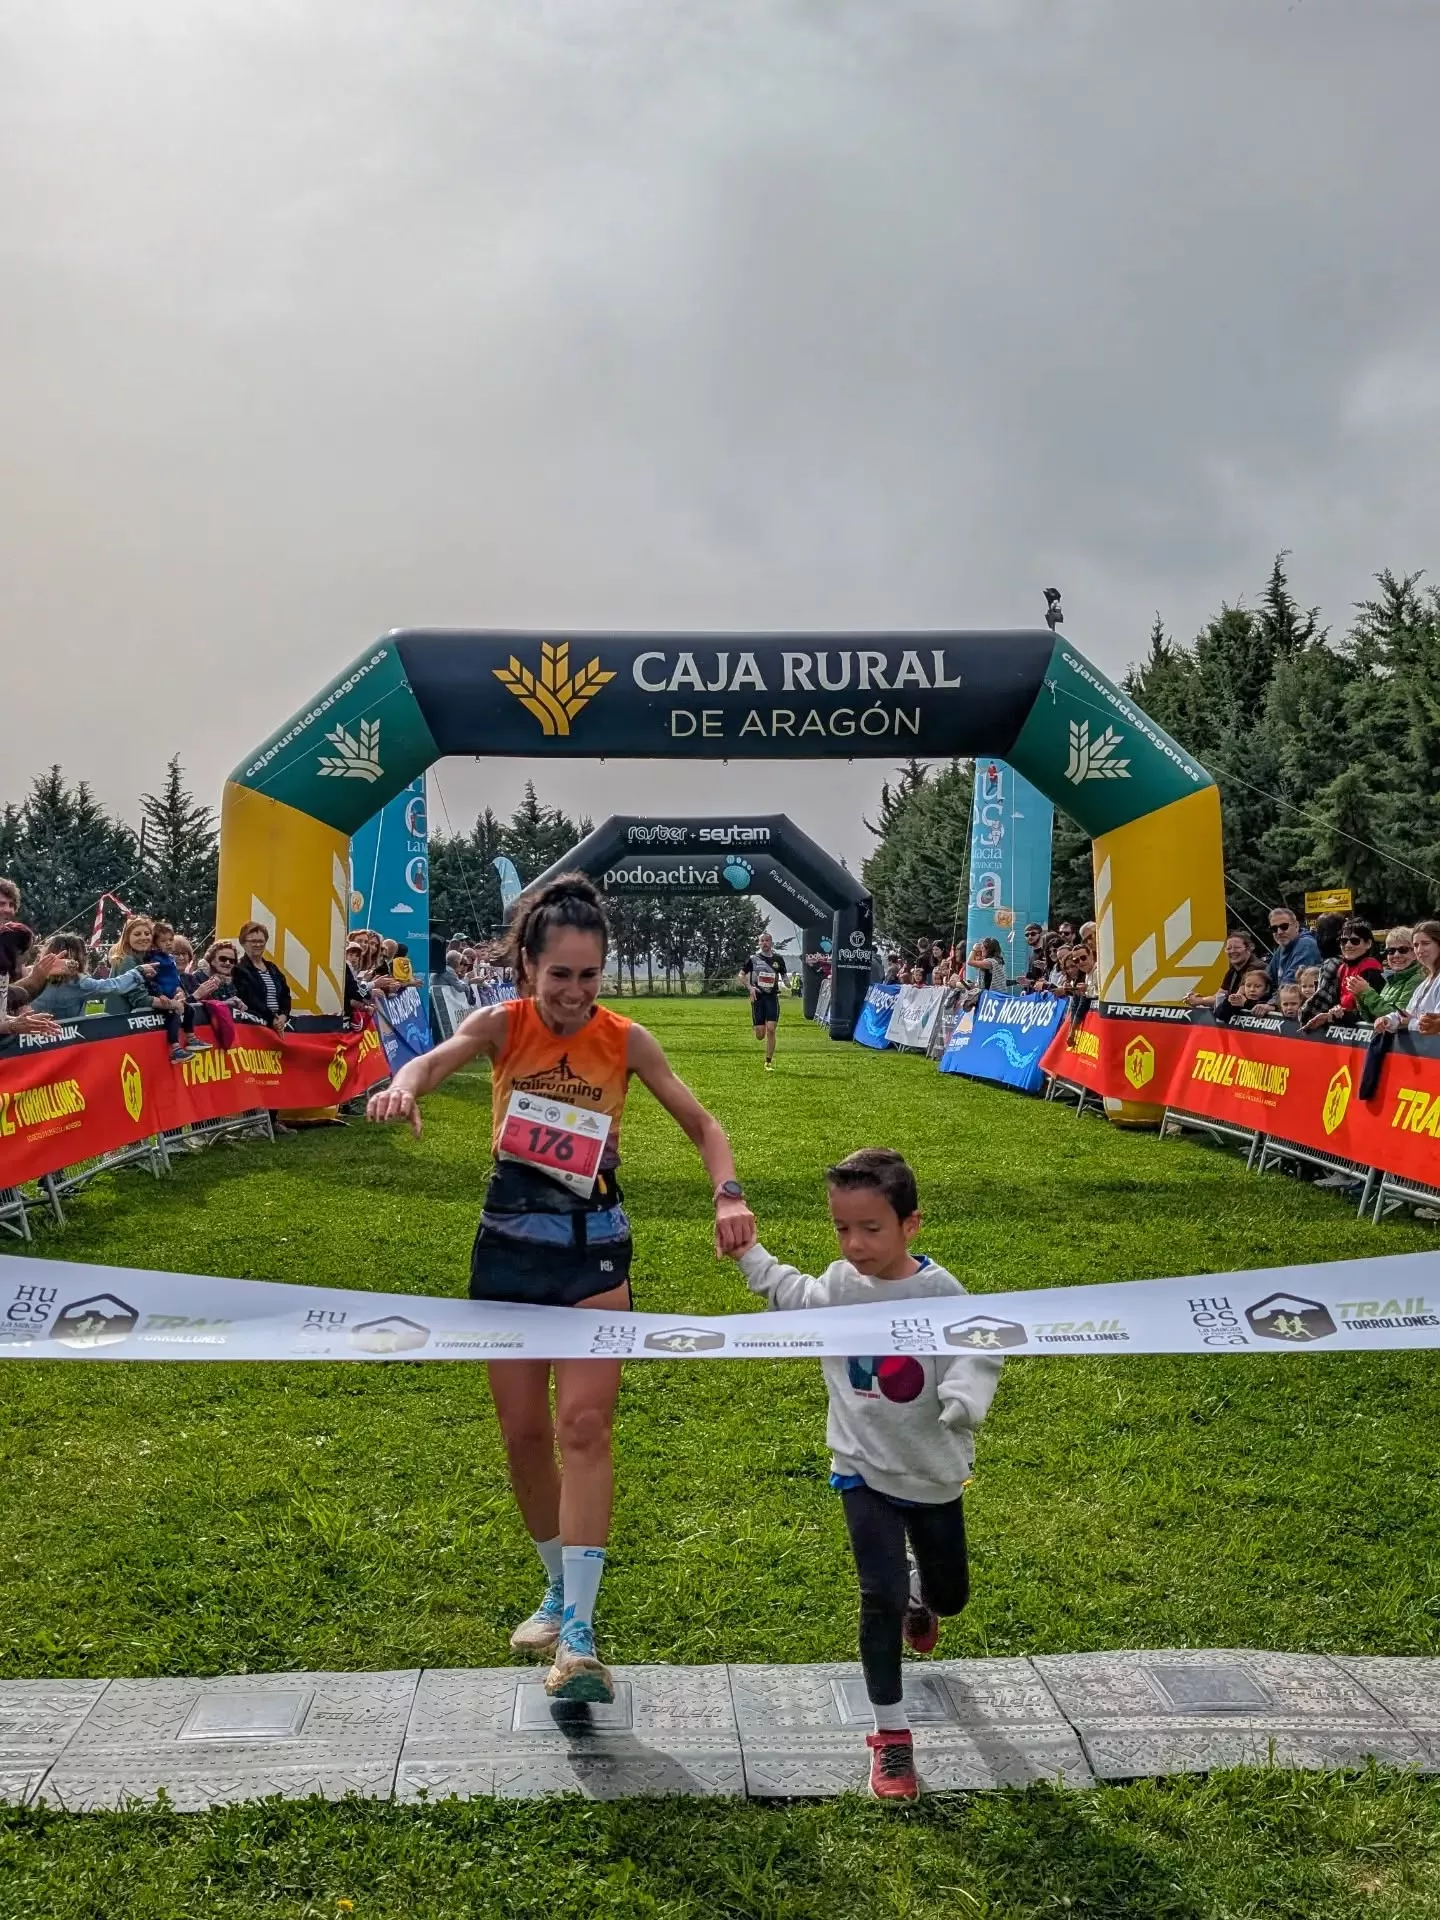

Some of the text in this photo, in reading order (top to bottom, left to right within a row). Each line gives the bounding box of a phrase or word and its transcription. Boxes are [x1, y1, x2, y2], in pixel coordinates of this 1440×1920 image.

[632, 648, 961, 692] CAJA RURAL
[245, 649, 388, 777] cajaruraldearagon.es
[670, 700, 922, 737] DE ARAGÓN
[1062, 652, 1200, 782] cajaruraldearagon.es
[628, 825, 688, 841] raster
[699, 825, 770, 845] seytam
[603, 866, 719, 889] podoactiva
[769, 869, 783, 884] Pisa
[797, 893, 809, 906] vive
[808, 902, 828, 920] mejor
[979, 992, 1058, 1034] Los Monegros
[1107, 1005, 1192, 1021] FIREHAWK
[1228, 1015, 1284, 1034] FIREHAWK
[1191, 1049, 1290, 1096] TRAIL TORROLLONES
[511, 1076, 603, 1101] trailrunning
[529, 1126, 574, 1161] 176
[1334, 1295, 1435, 1320] TRAIL
[1031, 1318, 1128, 1335] TRAIL
[1342, 1314, 1440, 1331] TORROLLONES
[1034, 1332, 1131, 1343] TORROLLONES
